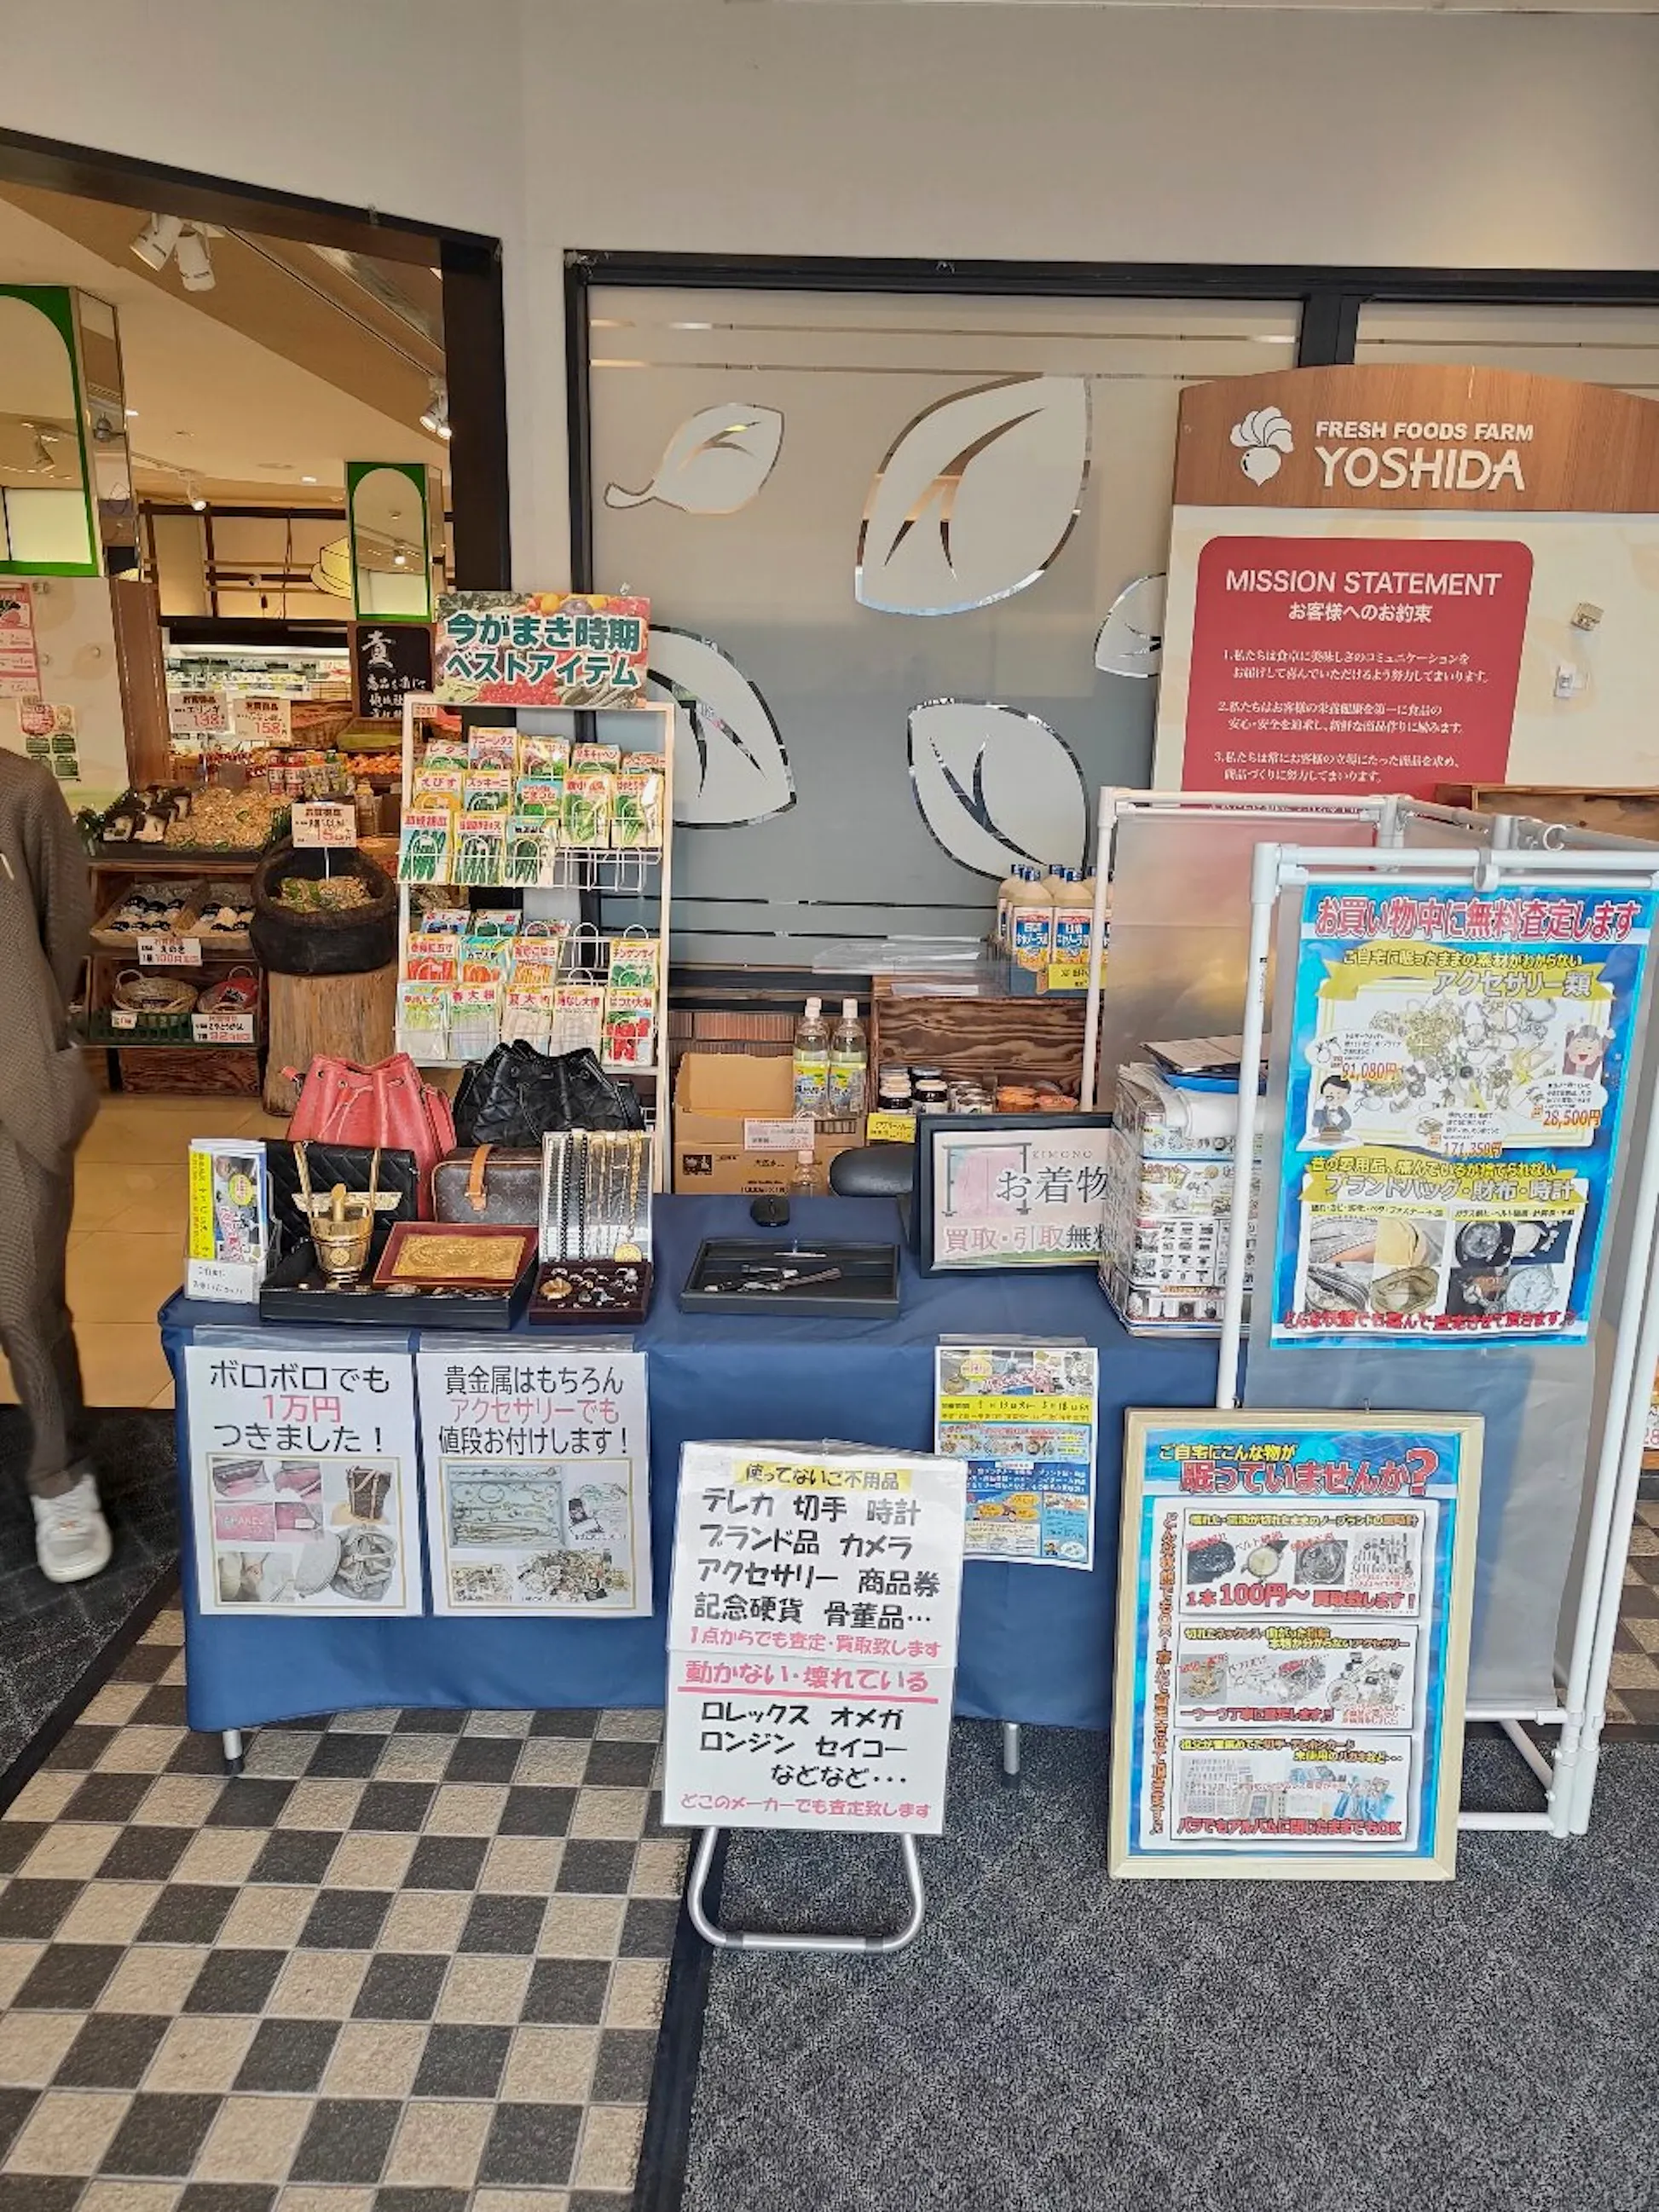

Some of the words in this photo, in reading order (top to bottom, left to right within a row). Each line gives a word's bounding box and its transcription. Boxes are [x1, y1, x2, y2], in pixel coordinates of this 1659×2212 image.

[1315, 421, 1387, 440] FRESH
[1393, 422, 1467, 441] FOODS
[1474, 423, 1534, 442] FARM
[1314, 446, 1525, 490] YOSHIDA
[1225, 569, 1337, 593] MISSION
[1344, 571, 1503, 596] STATEMENT
[1288, 602, 1432, 623] お客様へのお約束
[446, 613, 641, 652] 今がまき時期
[445, 651, 639, 687] ベストアイテム
[467, 777, 509, 787] ズッキーニ
[1315, 896, 1642, 941] お買い物中に無料査定します
[1432, 969, 1593, 997] アクセサリー類
[996, 1165, 1107, 1204] お着物
[1325, 1175, 1575, 1200] ブランドバッグ・財布・時計
[210, 1360, 390, 1393] ボロボロでも
[443, 1366, 623, 1395] 貴金属はもちろん
[263, 1395, 342, 1423] 1万円
[450, 1398, 621, 1424] アクセサリーでも
[213, 1424, 384, 1453] つきました！
[438, 1426, 630, 1456] 値段お付けします！
[1159, 1443, 1297, 1460] ご自宅にこんな物が
[745, 1463, 899, 1491] 使ってないご不用品
[1180, 1447, 1439, 1497] 眠っていませんか？
[702, 1487, 774, 1517] テレカ
[793, 1494, 848, 1523] 切手
[865, 1499, 922, 1527] 時計
[699, 1524, 820, 1556] ブランド品
[839, 1533, 913, 1560] カメラ
[697, 1558, 839, 1589] アクセサリー
[858, 1568, 941, 1597] 商品券
[693, 1591, 804, 1625] 記念硬貨
[690, 1626, 942, 1658] 1点からでも査定・買取致します
[685, 1660, 929, 1693] 動かない・壊れている
[702, 1701, 810, 1726] ロレックス
[830, 1707, 905, 1730] オメガ
[700, 1730, 796, 1755] ロンジン
[815, 1736, 909, 1759] セイコー
[680, 1793, 932, 1819] どこのメーカーでも査定致します
